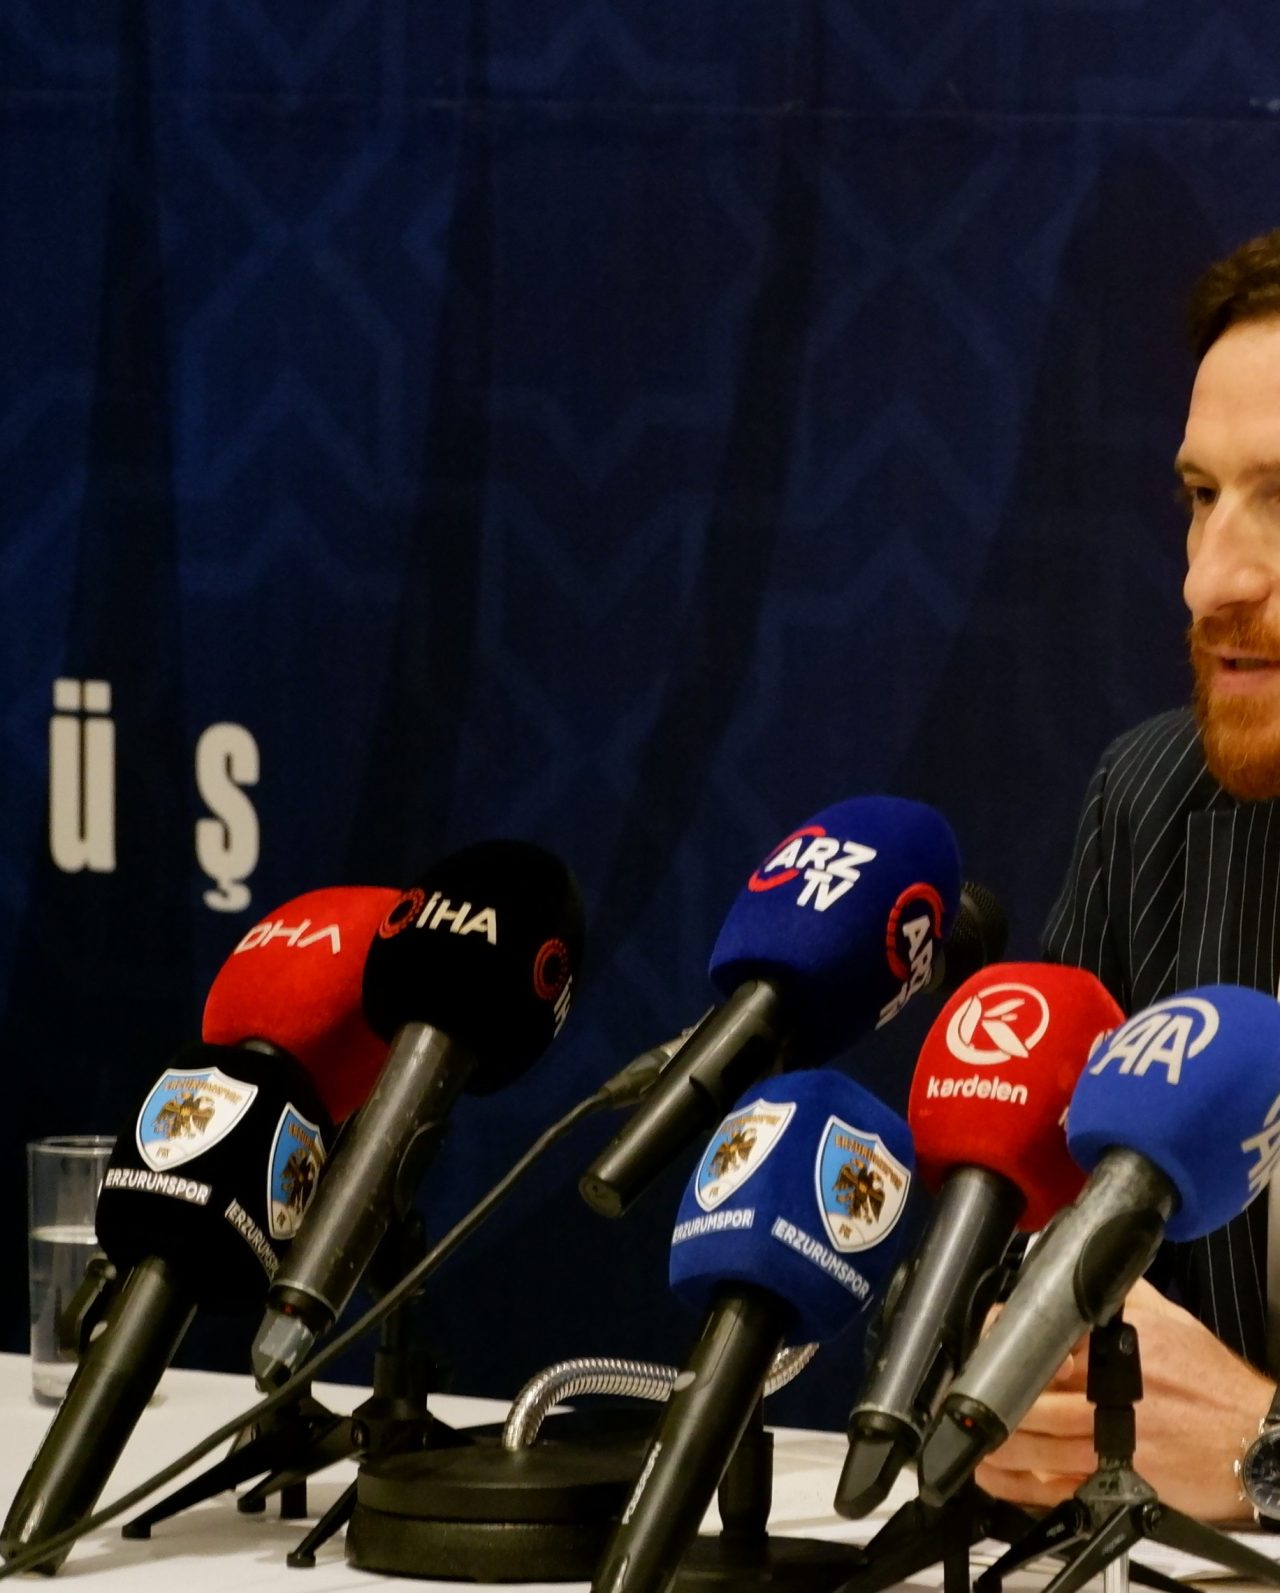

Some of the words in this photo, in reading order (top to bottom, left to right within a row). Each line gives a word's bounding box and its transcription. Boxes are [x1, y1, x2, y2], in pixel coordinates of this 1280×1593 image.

[764, 836, 877, 882] ARZ
[796, 868, 855, 912] TV
[232, 918, 341, 955] DHA
[415, 890, 497, 945] İHA
[1089, 1012, 1194, 1086] AA
[926, 1073, 1028, 1106] kardelen
[105, 1168, 210, 1204] ERZURUMSPOR
[672, 1210, 752, 1240] ERZURUMSPOR
[775, 1218, 870, 1299] ERZURUMSPOR
